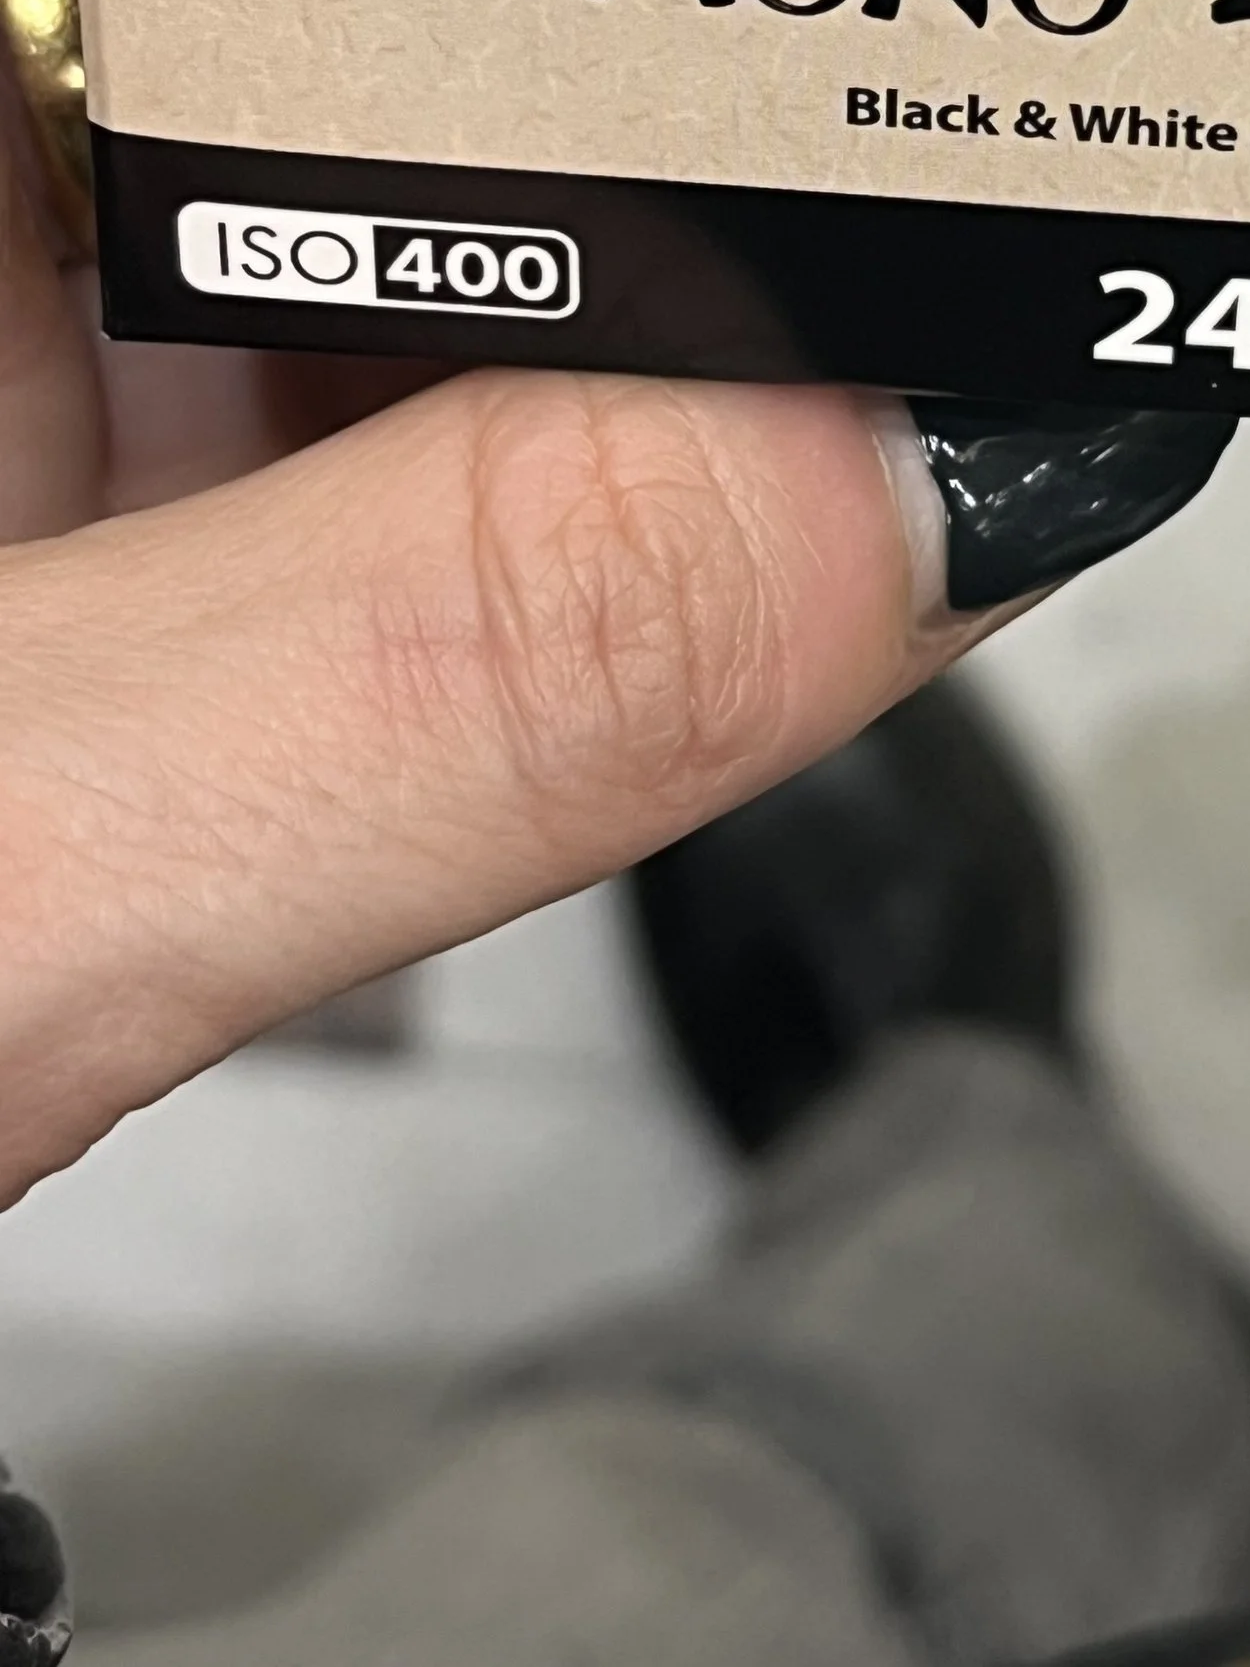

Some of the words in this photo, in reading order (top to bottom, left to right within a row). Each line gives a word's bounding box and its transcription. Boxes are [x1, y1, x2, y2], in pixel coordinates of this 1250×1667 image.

[845, 87, 999, 139] Black
[1013, 100, 1057, 140] &
[1070, 104, 1238, 153] White
[217, 221, 358, 285] ISO
[385, 238, 560, 302] 400
